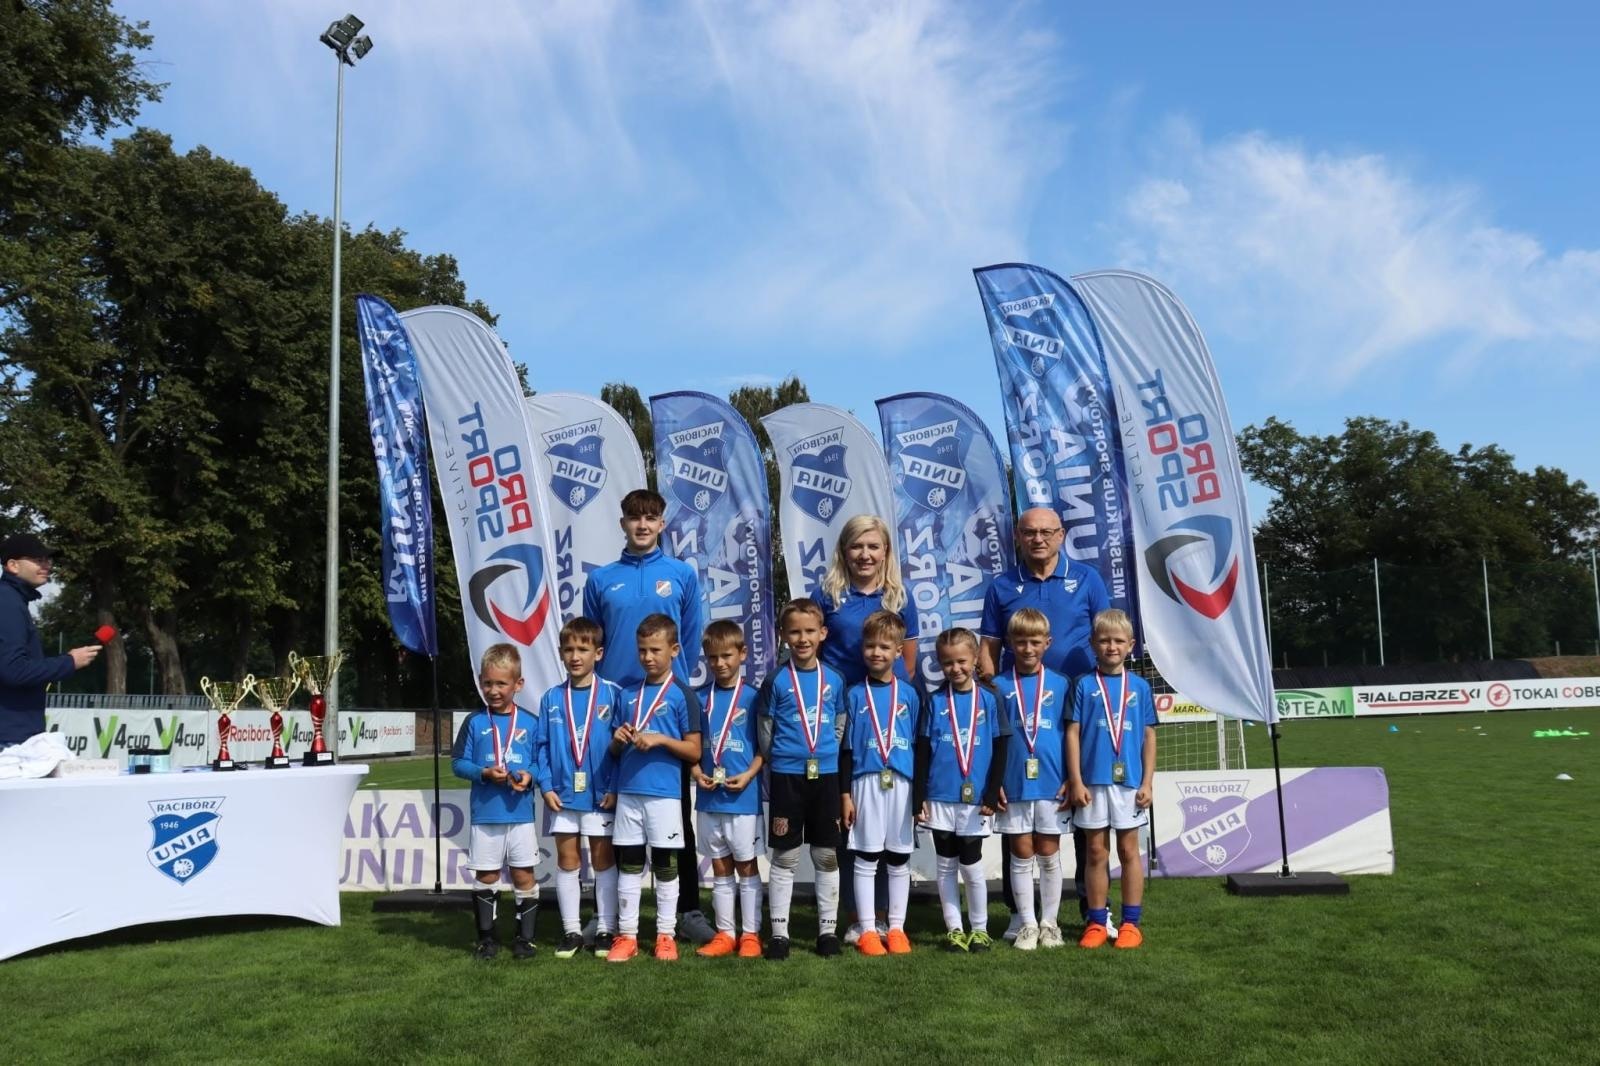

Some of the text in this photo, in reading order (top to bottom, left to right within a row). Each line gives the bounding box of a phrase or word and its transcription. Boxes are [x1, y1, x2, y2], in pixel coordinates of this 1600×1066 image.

[1513, 687, 1558, 700] TOKAI
[1291, 701, 1346, 716] TEAM
[230, 724, 271, 742] Racibórz
[157, 800, 216, 812] RACIBÓRZ
[1189, 804, 1208, 812] 1946
[160, 821, 179, 829] 1946
[1186, 812, 1241, 846] UNIA
[154, 828, 210, 860] UNIA
